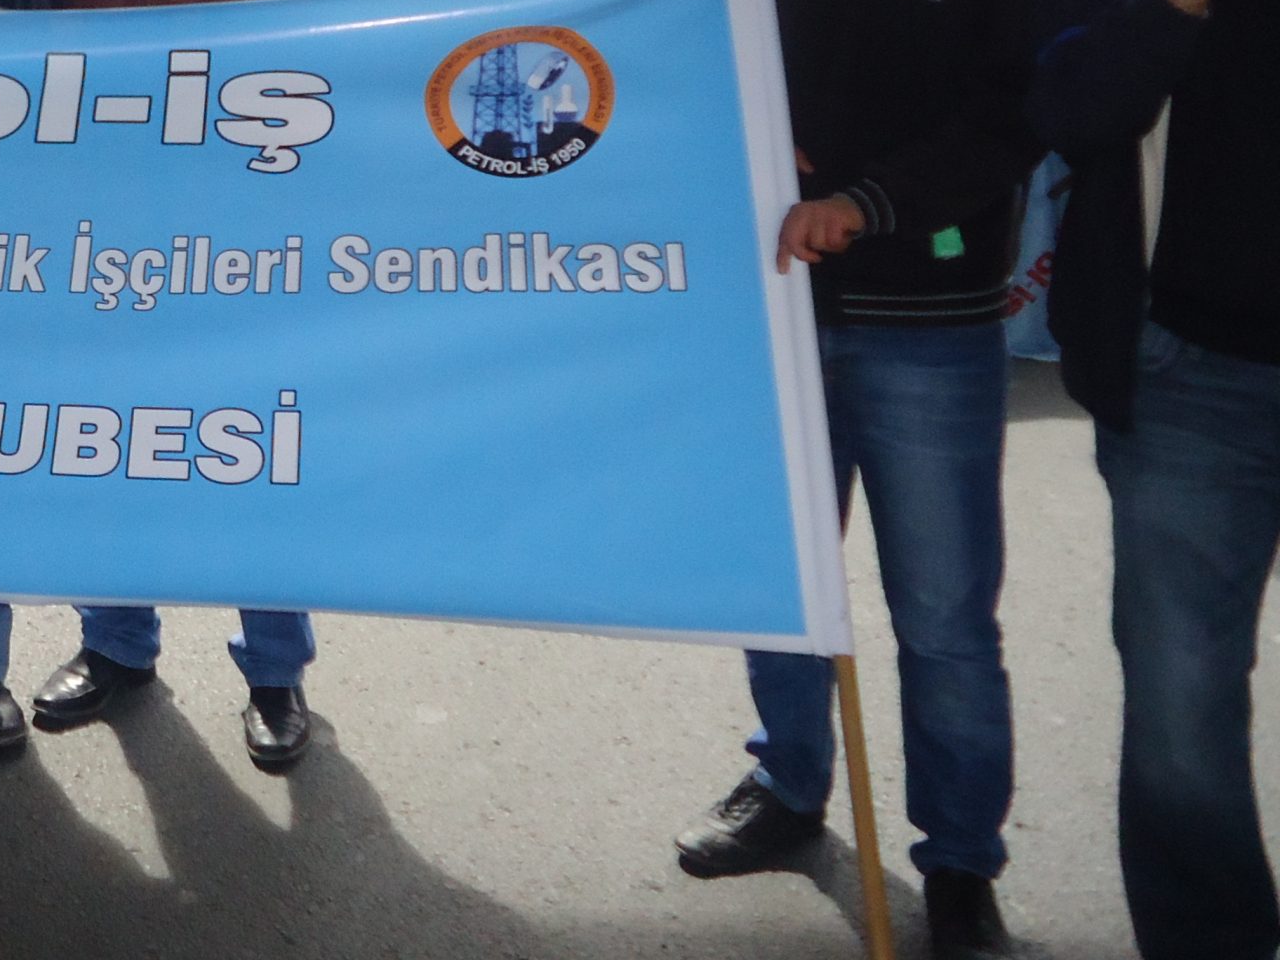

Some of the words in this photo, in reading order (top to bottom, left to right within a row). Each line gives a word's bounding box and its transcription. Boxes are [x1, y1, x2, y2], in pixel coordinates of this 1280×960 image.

[551, 137, 586, 166] 1950
[68, 220, 302, 311] İşçileri
[327, 232, 688, 295] Sendikası
